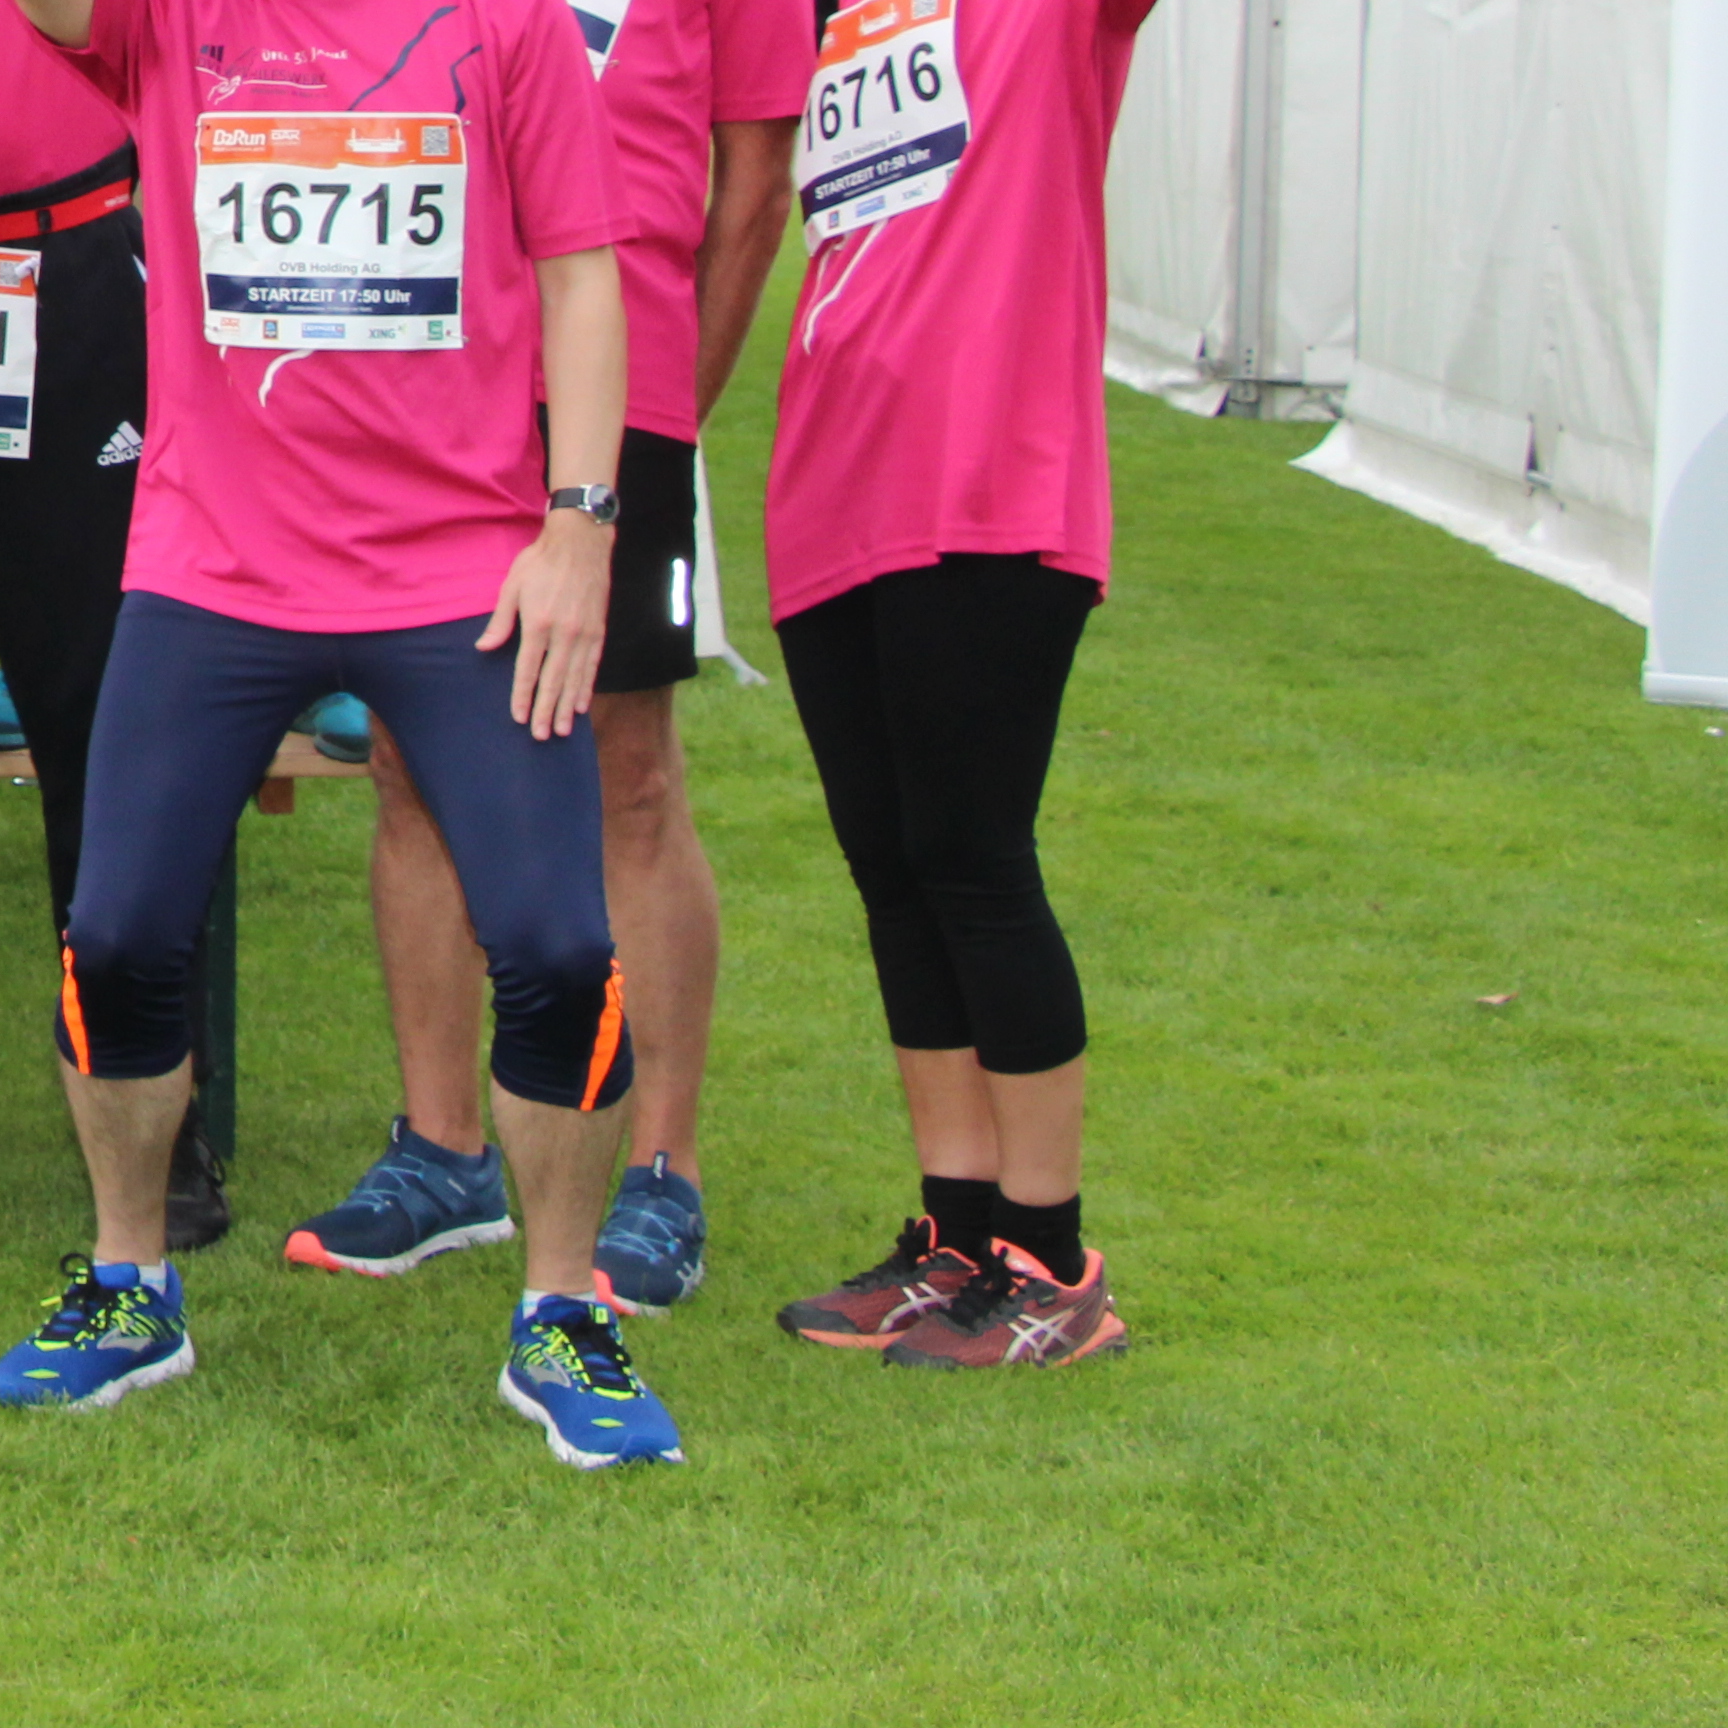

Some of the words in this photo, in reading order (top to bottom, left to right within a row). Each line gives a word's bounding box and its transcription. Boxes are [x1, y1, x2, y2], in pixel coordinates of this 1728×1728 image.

[815, 165, 875, 200] STARTZEIT
[877, 155, 907, 176] 17:50
[908, 147, 931, 164] Uhr
[218, 182, 444, 246] 16715
[278, 262, 306, 273] OVB
[309, 262, 358, 274] Holding
[361, 263, 381, 274] AG
[247, 287, 334, 302] STARTZEIT
[340, 288, 380, 303] 17:50
[384, 290, 411, 303] Uhr
[368, 328, 396, 340] XING
[97, 445, 143, 466] adida
